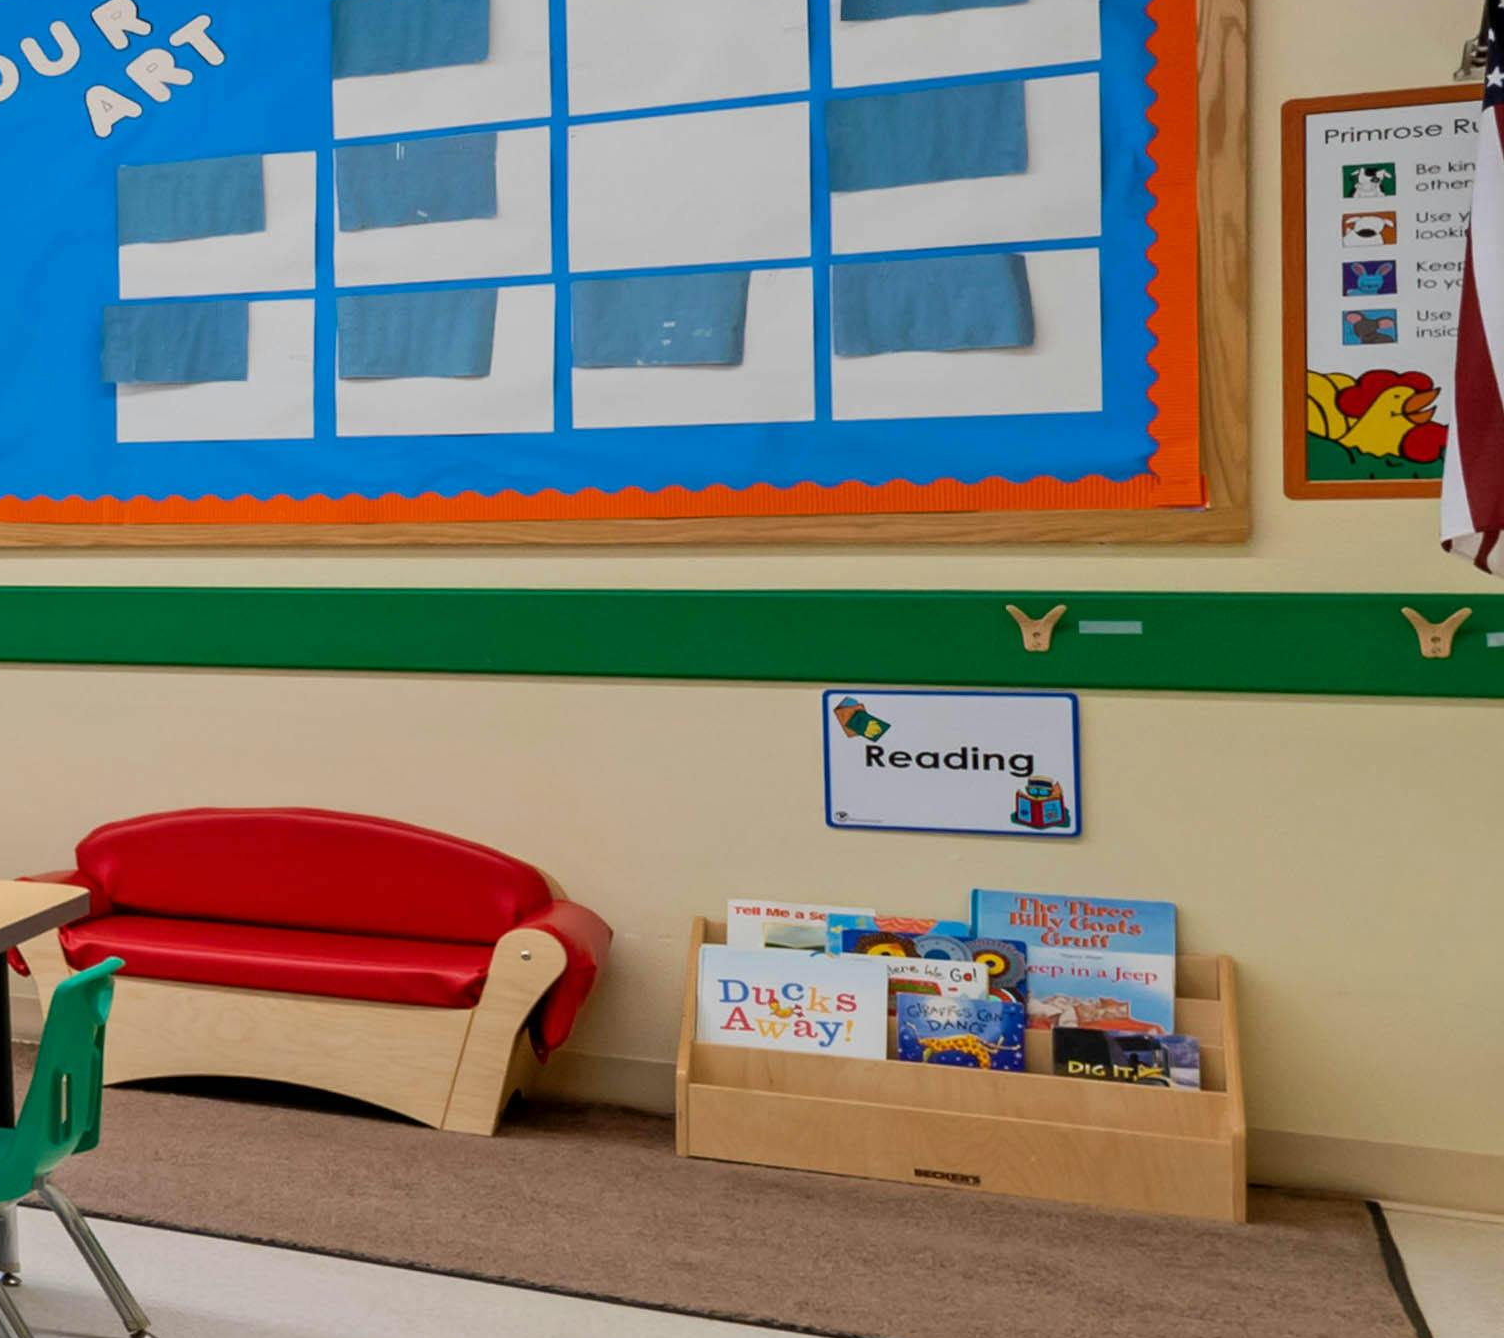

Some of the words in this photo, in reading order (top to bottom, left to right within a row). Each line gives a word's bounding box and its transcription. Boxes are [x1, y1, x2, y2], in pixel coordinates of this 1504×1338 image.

[85, 15, 225, 138] ART
[1325, 124, 1442, 144] Primrose
[1454, 118, 1479, 134] Ru
[1416, 163, 1441, 175] Be
[1448, 161, 1475, 172] kin
[1416, 211, 1451, 223] Use
[1416, 227, 1465, 239] looki
[1417, 278, 1437, 289] to
[1417, 310, 1452, 321] Use
[865, 745, 1034, 777] Reading
[735, 906, 761, 916] Tell
[766, 908, 790, 918] Me
[795, 911, 804, 920] a
[1016, 897, 1059, 913] The
[1065, 901, 1135, 919] Three
[1010, 913, 1062, 931] Billy
[1069, 916, 1143, 936] Goats
[1041, 932, 1110, 949] Gruff
[950, 967, 977, 982] Go!
[1028, 963, 1065, 979] eep
[1071, 964, 1090, 977] in
[1097, 969, 1106, 978] a
[1112, 966, 1159, 985] Jeep
[718, 979, 857, 1013] Ducks
[720, 1006, 855, 1048] Away!
[1068, 1059, 1106, 1078] DIG
